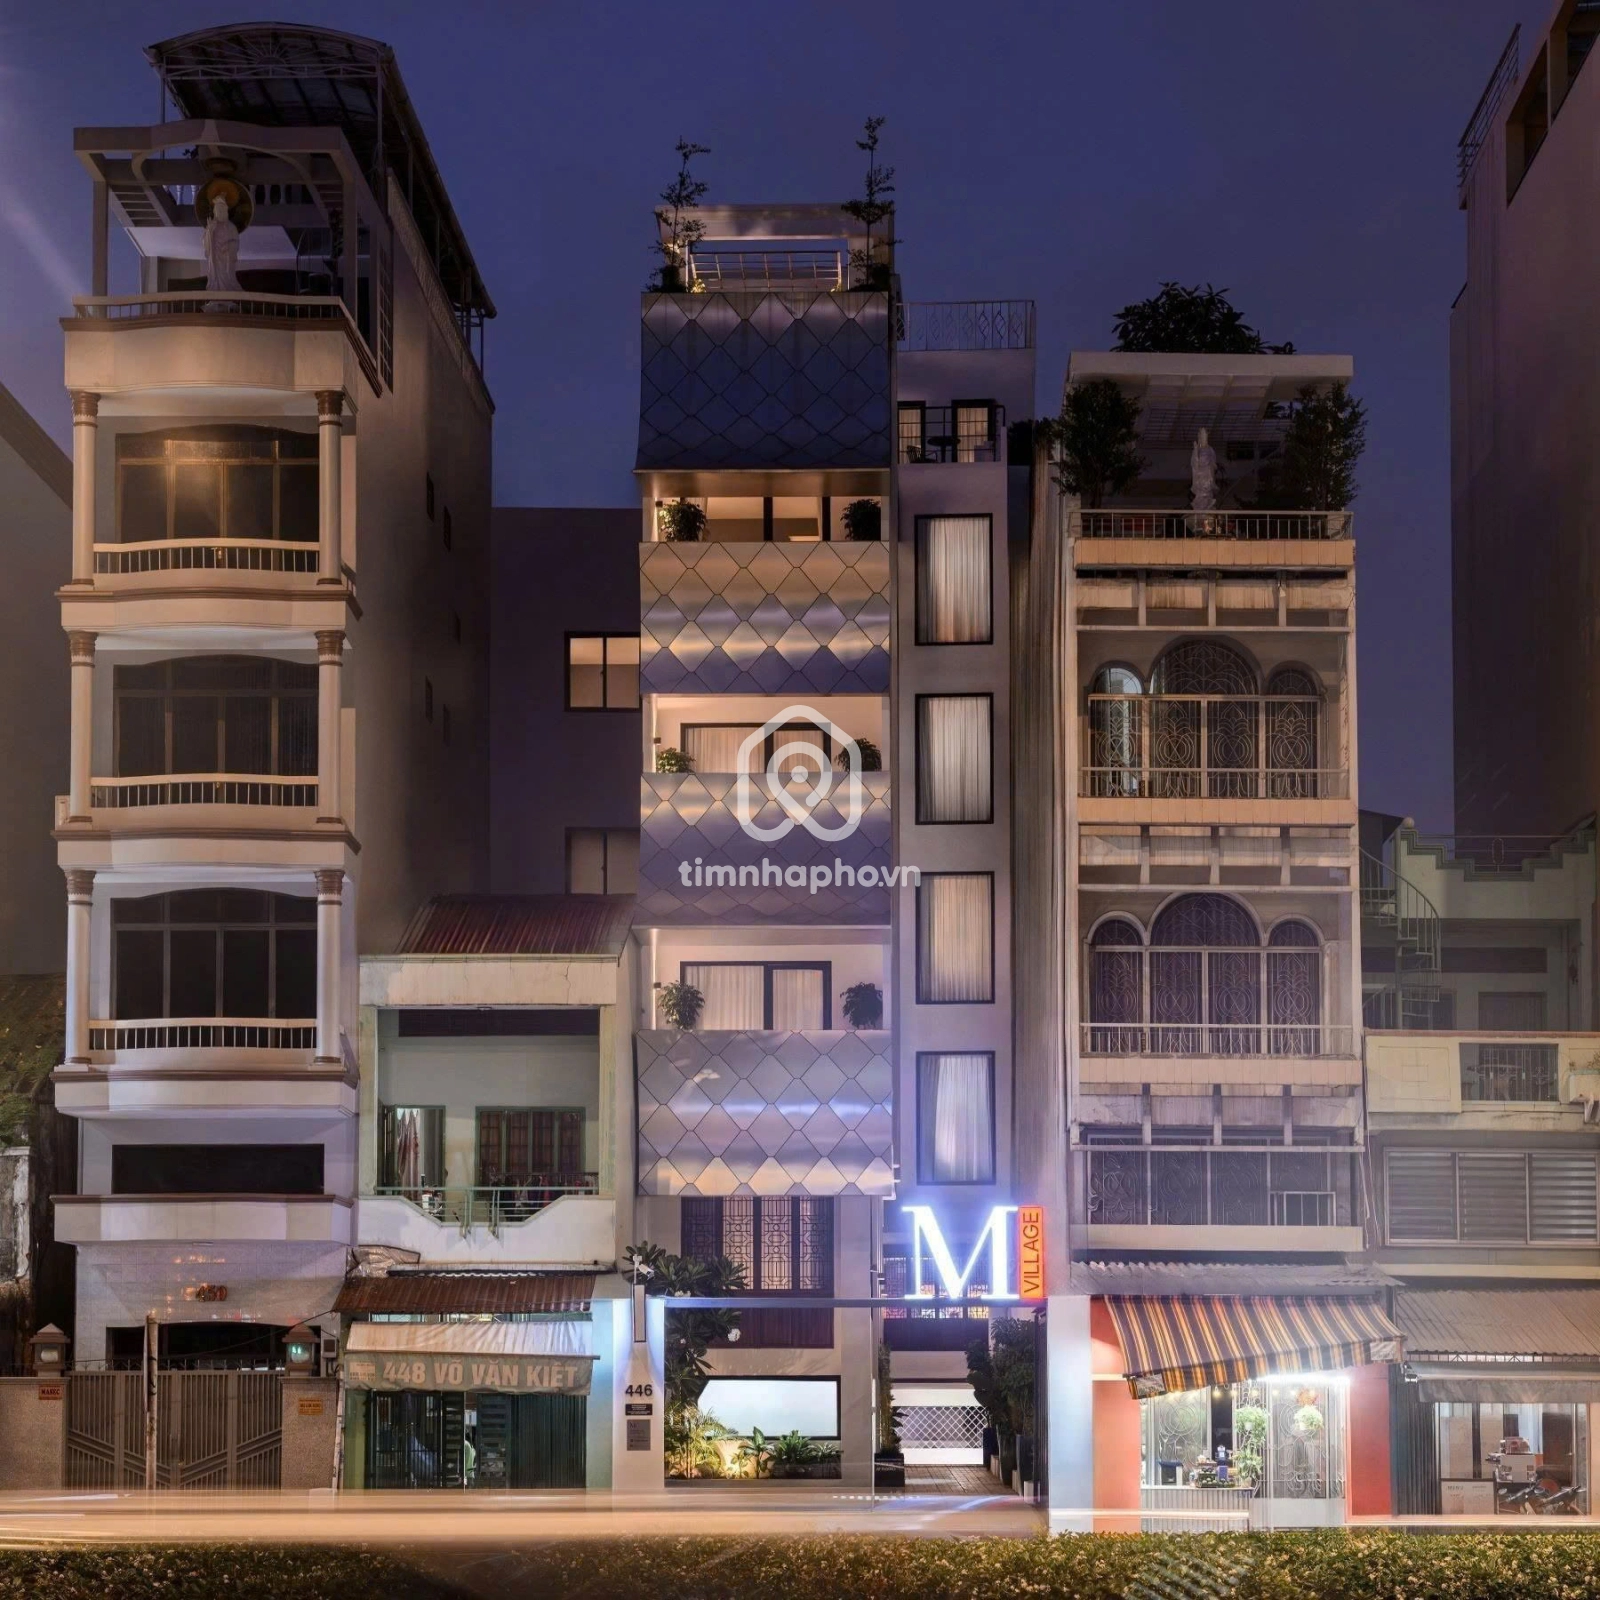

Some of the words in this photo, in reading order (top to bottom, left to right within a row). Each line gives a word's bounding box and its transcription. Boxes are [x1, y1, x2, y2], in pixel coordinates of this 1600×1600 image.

[901, 1205, 1019, 1300] M
[1023, 1212, 1040, 1293] VILLAGE
[383, 1361, 426, 1384] 448
[434, 1359, 464, 1385] VÕ
[471, 1359, 519, 1387] VĂN
[625, 1384, 653, 1397] 446
